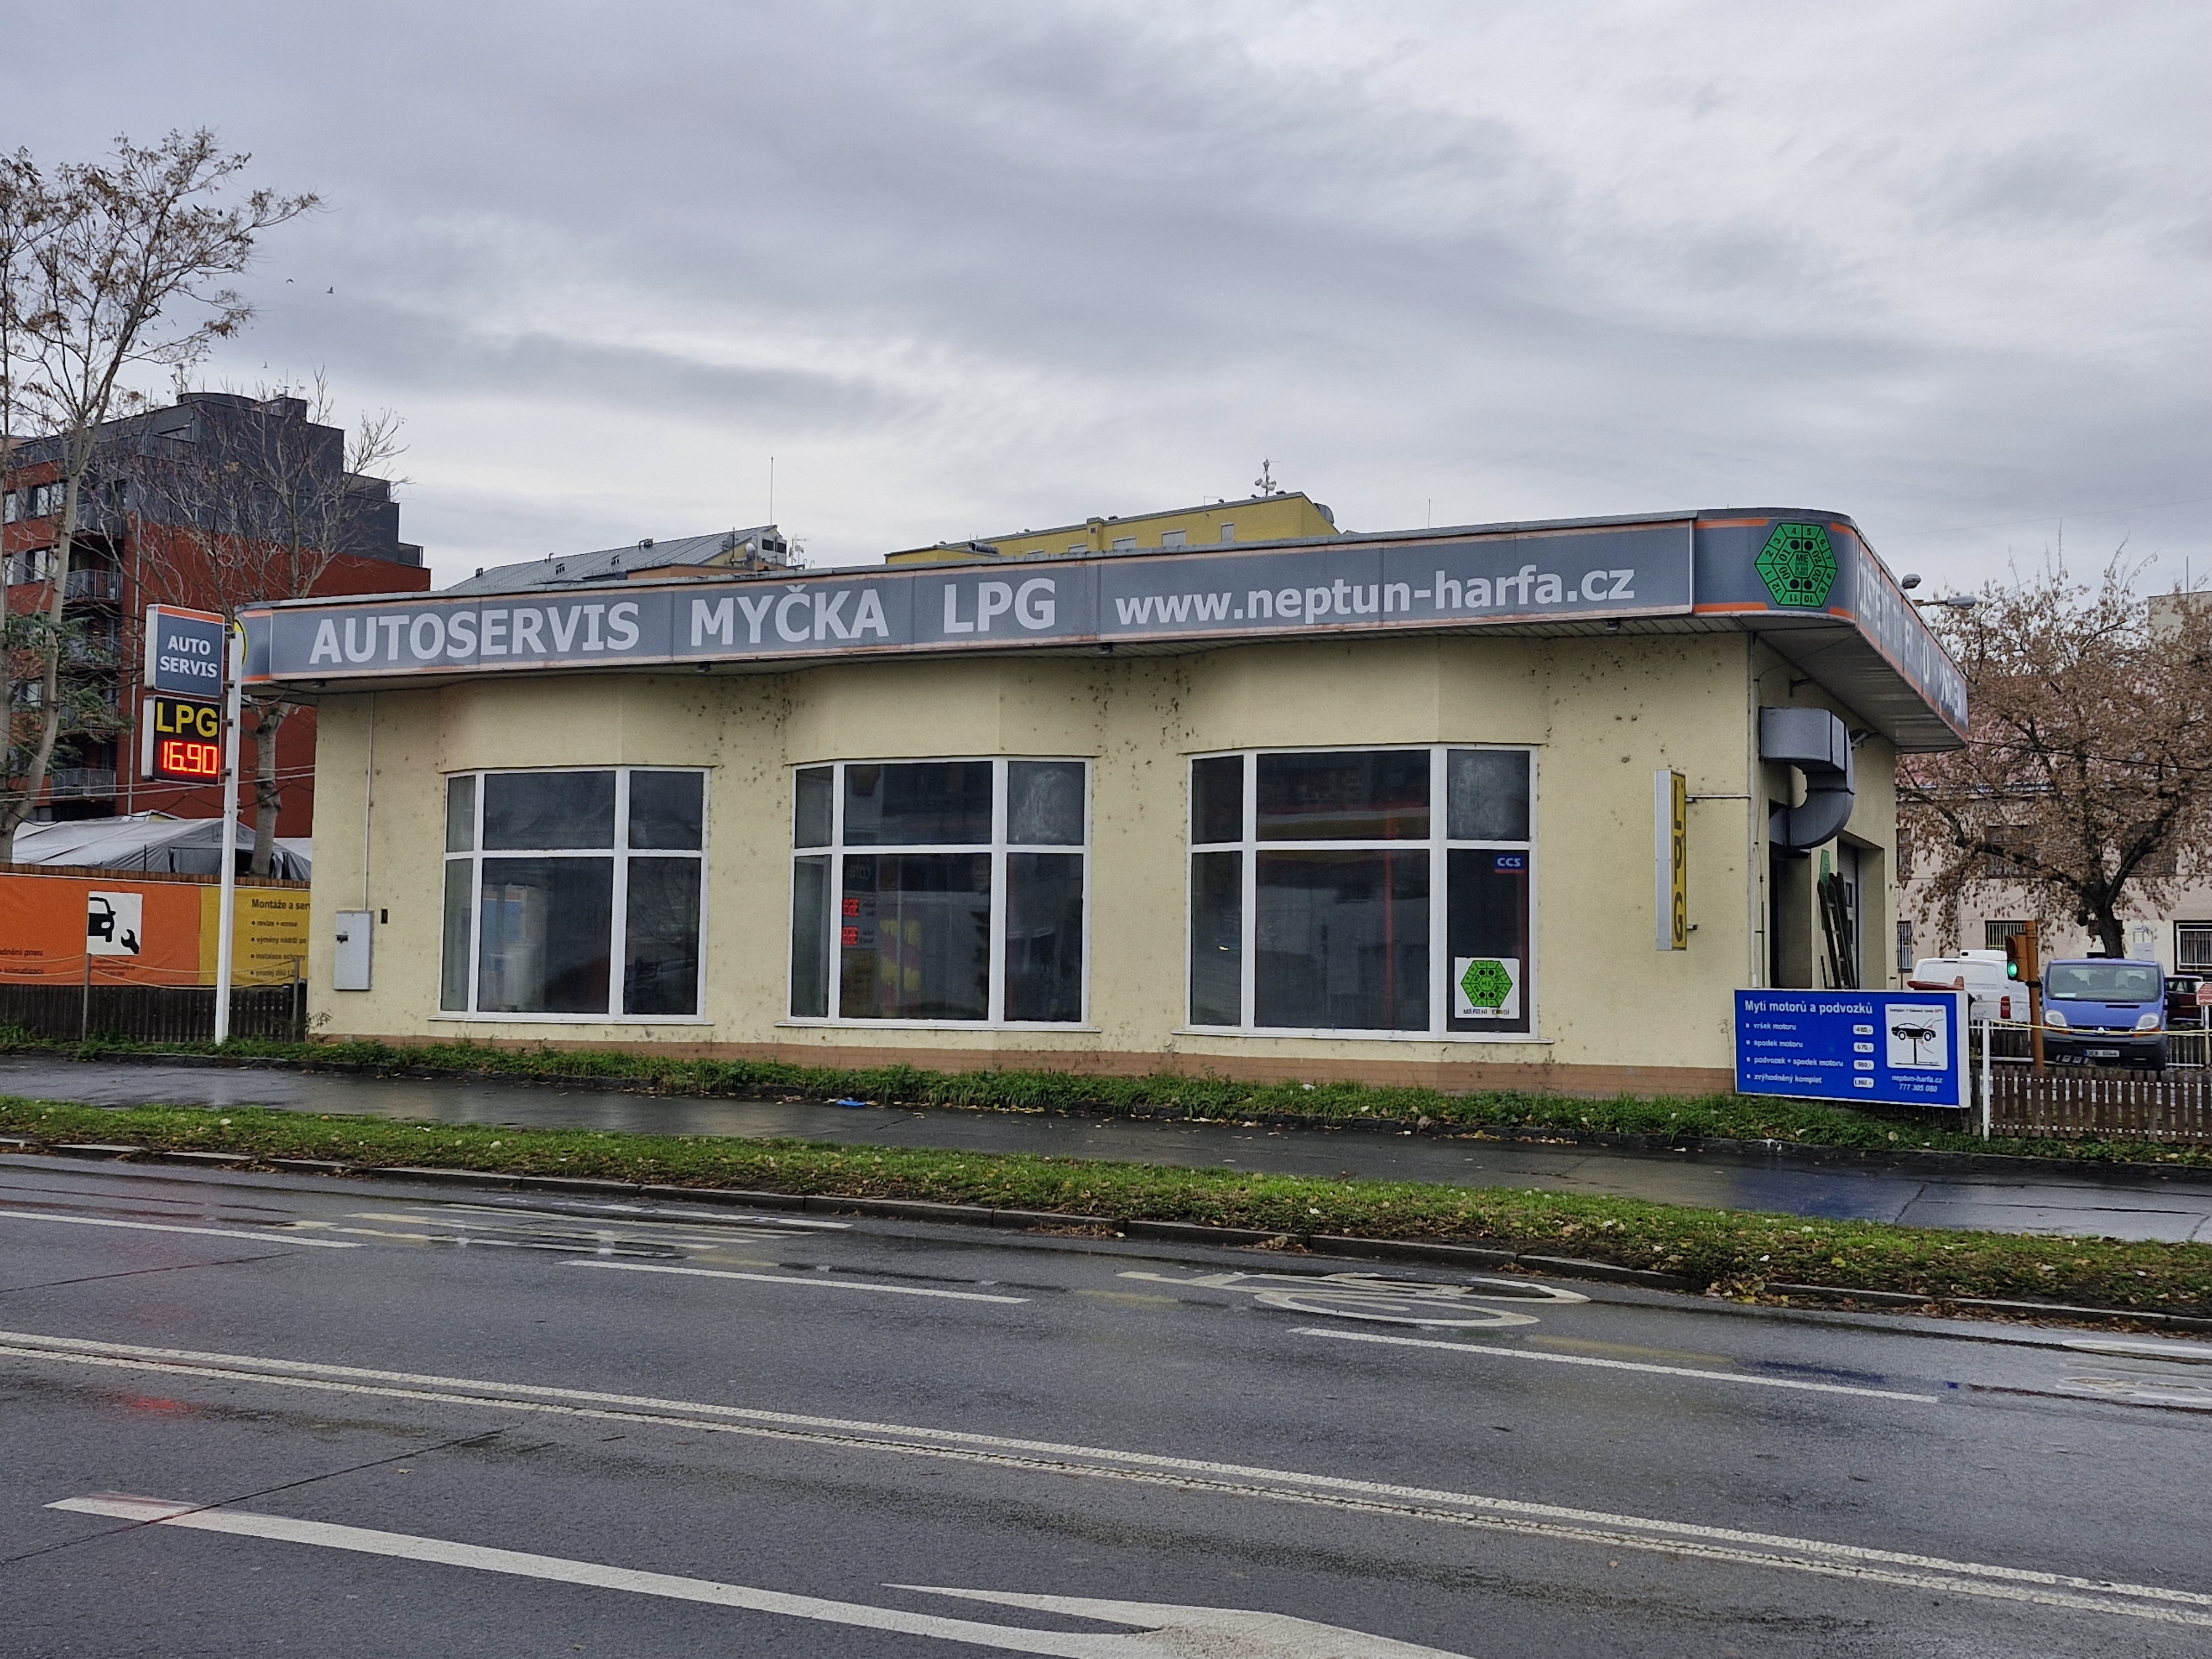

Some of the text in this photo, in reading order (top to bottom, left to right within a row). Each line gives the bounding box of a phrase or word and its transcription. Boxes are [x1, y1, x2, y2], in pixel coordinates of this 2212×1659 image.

[1779, 549, 1791, 561] 01
[1796, 554, 1808, 562] ME
[1779, 566, 1791, 580] 00
[309, 565, 1635, 664] AUTOSERVIS MYČKA LPG www.neptun-harfa.cz
[168, 635, 211, 655] AUTO
[159, 655, 218, 678] SERVIS
[156, 702, 218, 737] LPG
[1496, 857, 1521, 868] CCS
[1674, 779, 1683, 942] LPG
[252, 899, 286, 909] Montáže
[1745, 1000, 1873, 1016] Mytí motorů a podvozků
